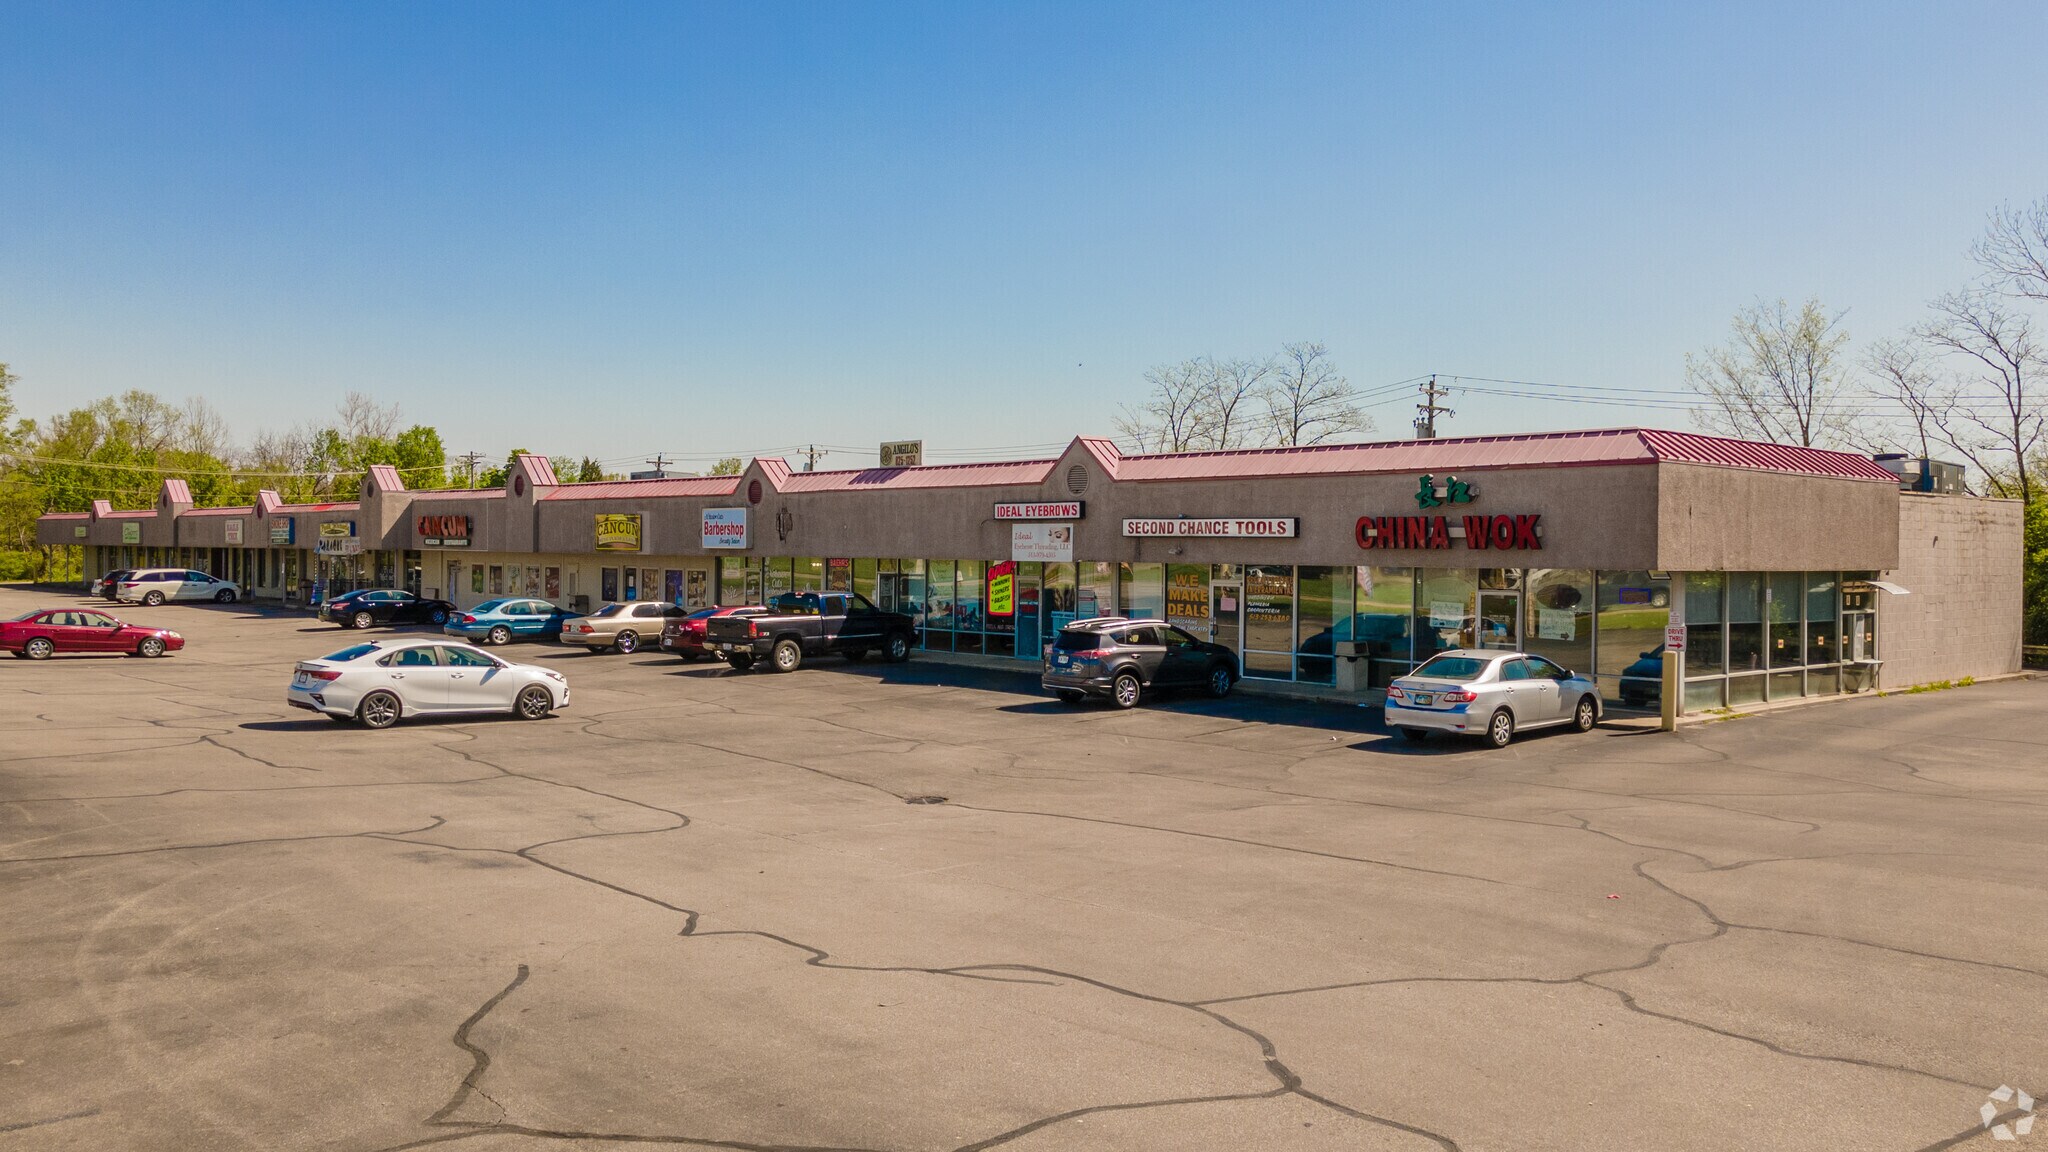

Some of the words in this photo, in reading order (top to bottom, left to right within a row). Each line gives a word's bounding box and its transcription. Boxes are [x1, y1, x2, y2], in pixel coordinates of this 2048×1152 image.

[893, 443, 919, 454] ANGILO'S
[997, 505, 1022, 518] IDEAL
[1025, 504, 1078, 517] EYEBROWS
[417, 515, 468, 537] CANCUN
[598, 521, 639, 536] CANCUN
[704, 521, 744, 539] Barbershop
[1127, 521, 1174, 535] SECOND
[1179, 521, 1229, 535] CHANCE
[1236, 521, 1286, 535] TOOLS
[1355, 515, 1450, 550] CHINA
[1462, 514, 1542, 550] WOK
[1015, 532, 1034, 541] Ideal
[1175, 574, 1199, 587] WE
[1169, 588, 1208, 602] MAKE
[1168, 603, 1209, 618] DEALS
